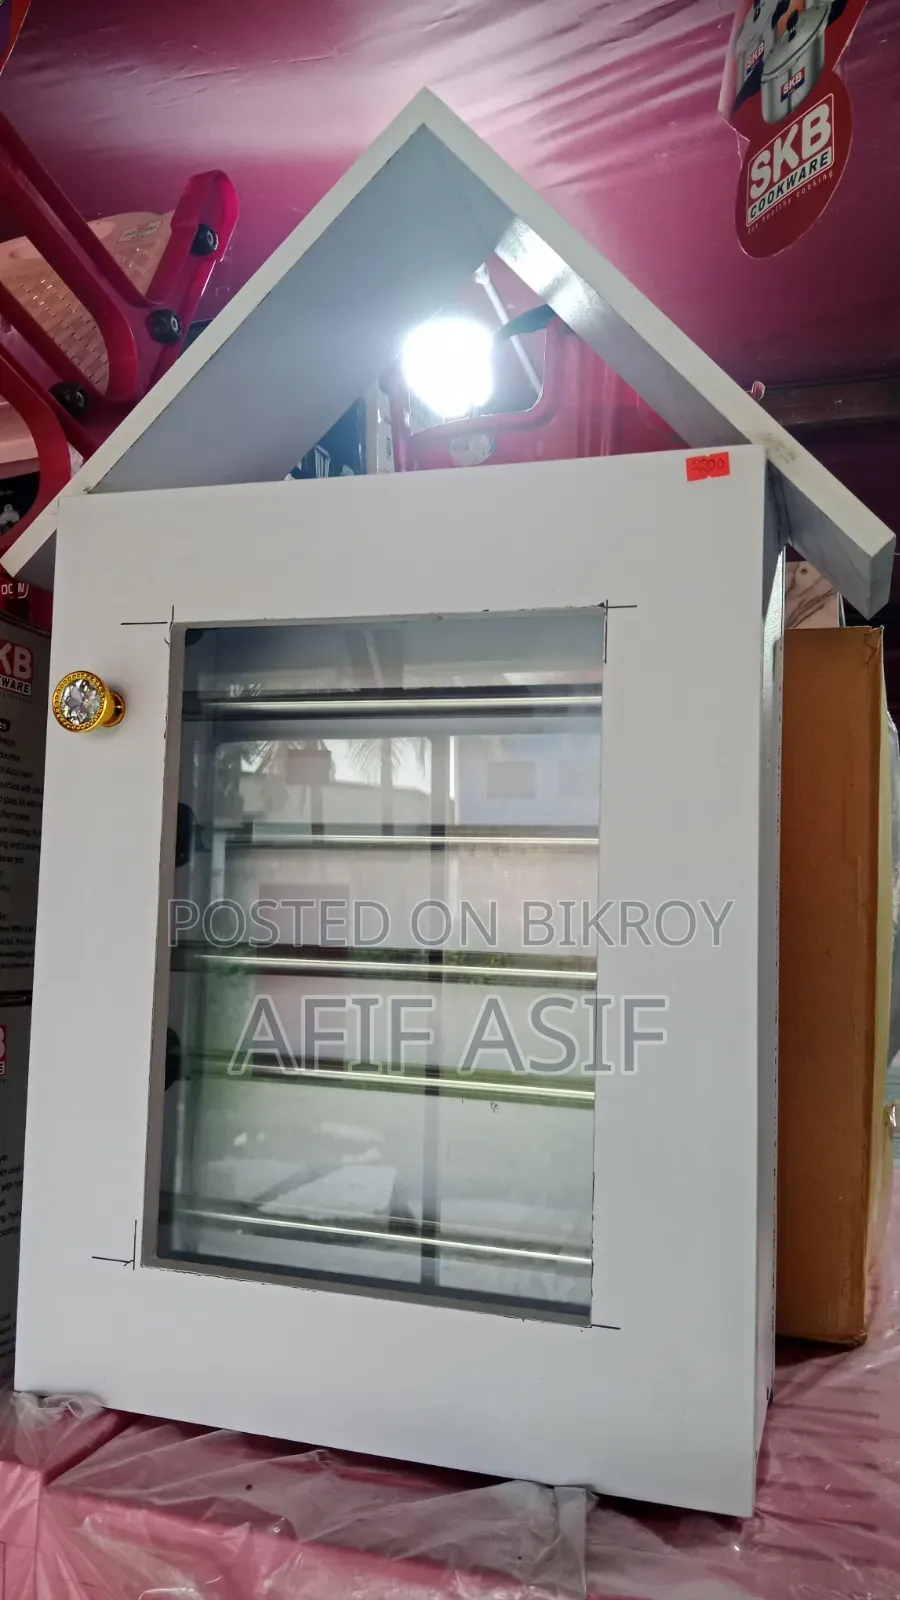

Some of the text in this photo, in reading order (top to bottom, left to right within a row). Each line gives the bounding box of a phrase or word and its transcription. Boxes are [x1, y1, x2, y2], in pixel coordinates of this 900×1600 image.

[747, 42, 764, 68] SKB
[783, 72, 802, 94] SKB
[750, 103, 832, 200] SKB
[750, 150, 829, 219] COOKWARE
[796, 170, 833, 198] cooking
